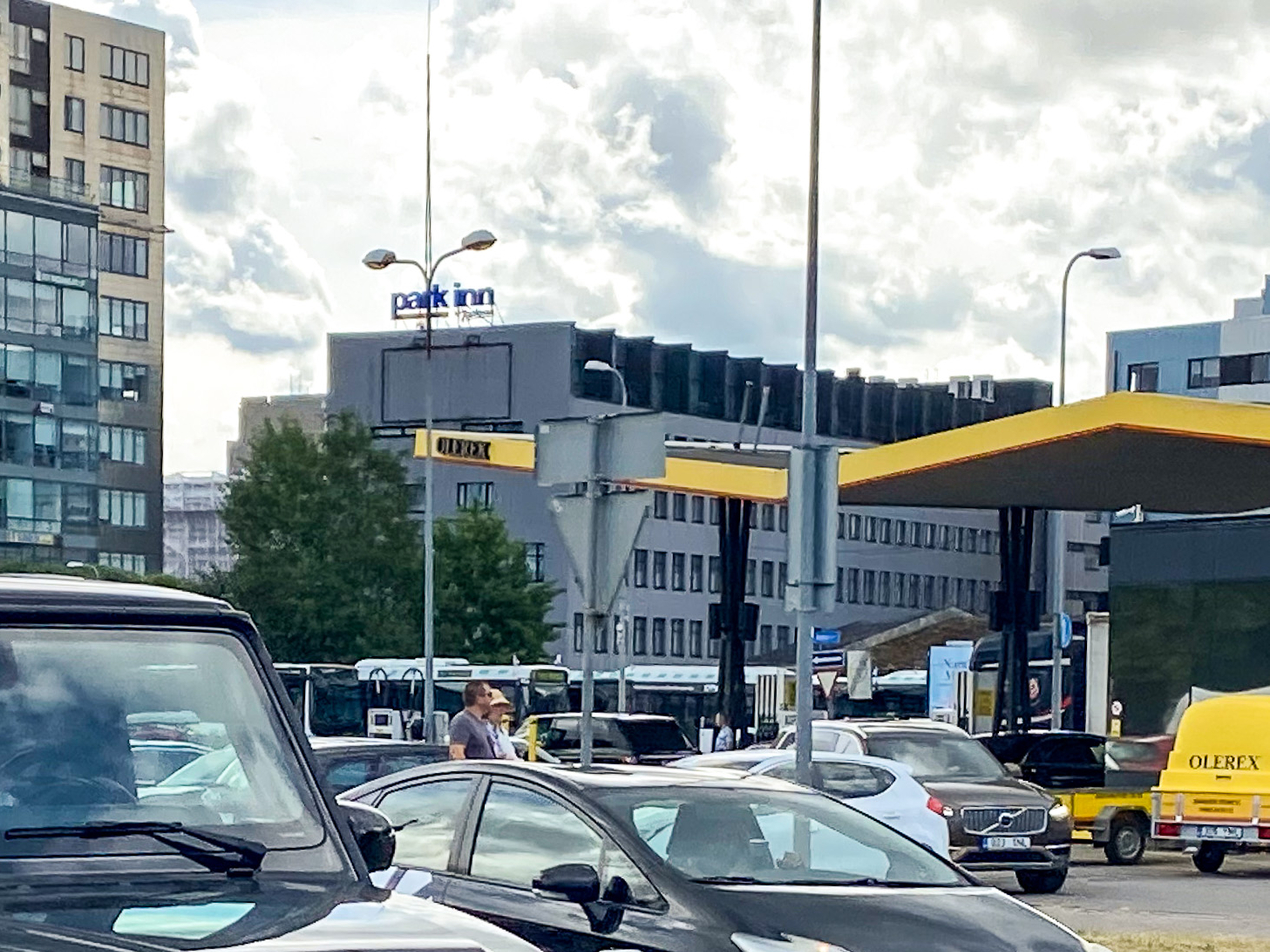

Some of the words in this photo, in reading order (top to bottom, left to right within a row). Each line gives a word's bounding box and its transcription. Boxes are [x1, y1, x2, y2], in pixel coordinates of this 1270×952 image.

[391, 284, 449, 320] park
[453, 282, 494, 307] inn
[1189, 754, 1261, 770] OLEREX
